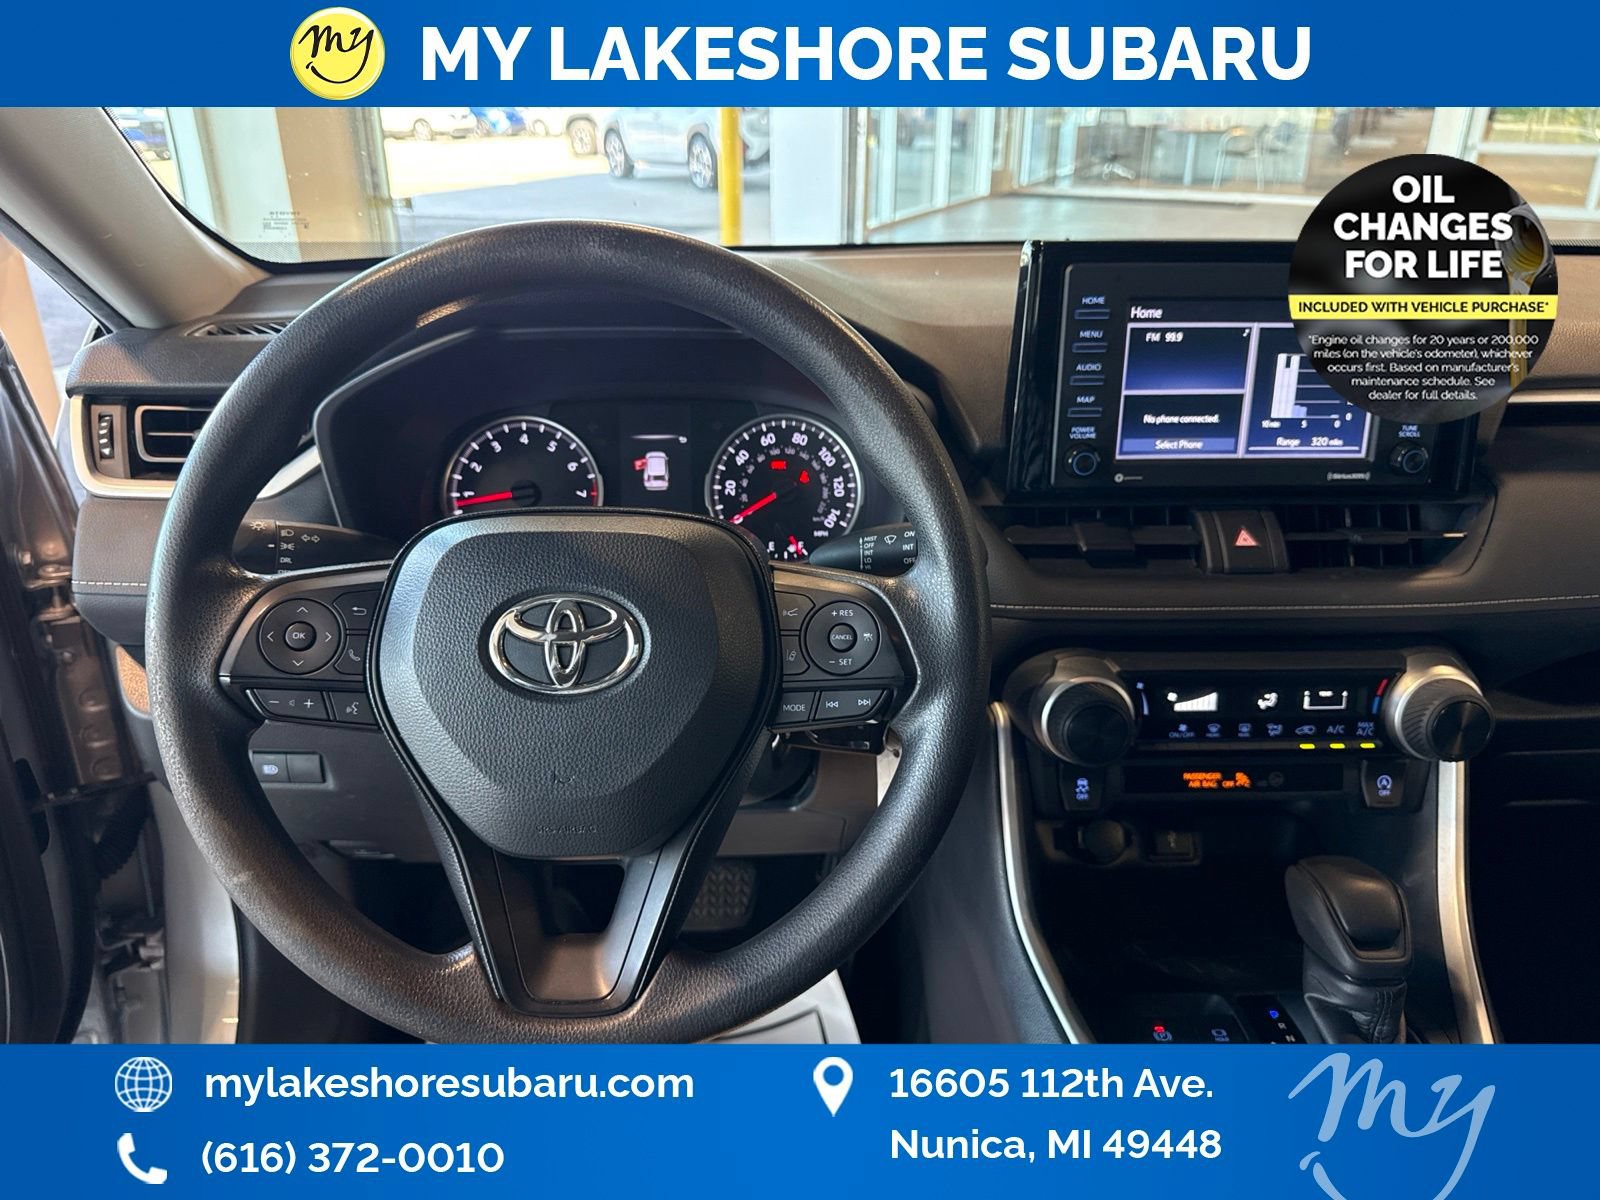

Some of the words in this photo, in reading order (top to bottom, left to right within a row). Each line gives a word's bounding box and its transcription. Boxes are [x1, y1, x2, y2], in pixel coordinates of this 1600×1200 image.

[1082, 296, 1105, 305] HOME
[1130, 306, 1163, 319] Home
[1080, 330, 1103, 338] MENU
[1146, 333, 1161, 342] FM
[1076, 363, 1101, 371] AUDIO
[1156, 415, 1178, 425] phone
[519, 433, 529, 445] 4
[760, 432, 776, 447] 60
[791, 432, 808, 446] 80
[1276, 437, 1300, 447] Range
[1310, 437, 1329, 446] 320
[490, 440, 502, 453] 3
[546, 440, 558, 453] 5
[1155, 440, 1178, 450] Select
[1179, 439, 1204, 450] Phone
[734, 449, 750, 466] 40
[820, 446, 836, 467] 100
[469, 461, 482, 473] 2
[567, 461, 579, 472] 6
[724, 479, 736, 496] 20
[833, 475, 845, 498] 120
[462, 490, 475, 498] 1
[575, 489, 587, 498] 7
[823, 508, 841, 528] 140
[904, 530, 916, 538] ON
[902, 543, 914, 551] INT
[839, 609, 854, 617] RES
[292, 631, 306, 640] OK
[831, 633, 853, 641] CANCEL
[838, 658, 853, 666] SET
[782, 704, 806, 712] MODE
[1326, 724, 1345, 734] A/C
[1356, 727, 1375, 736] A/C
